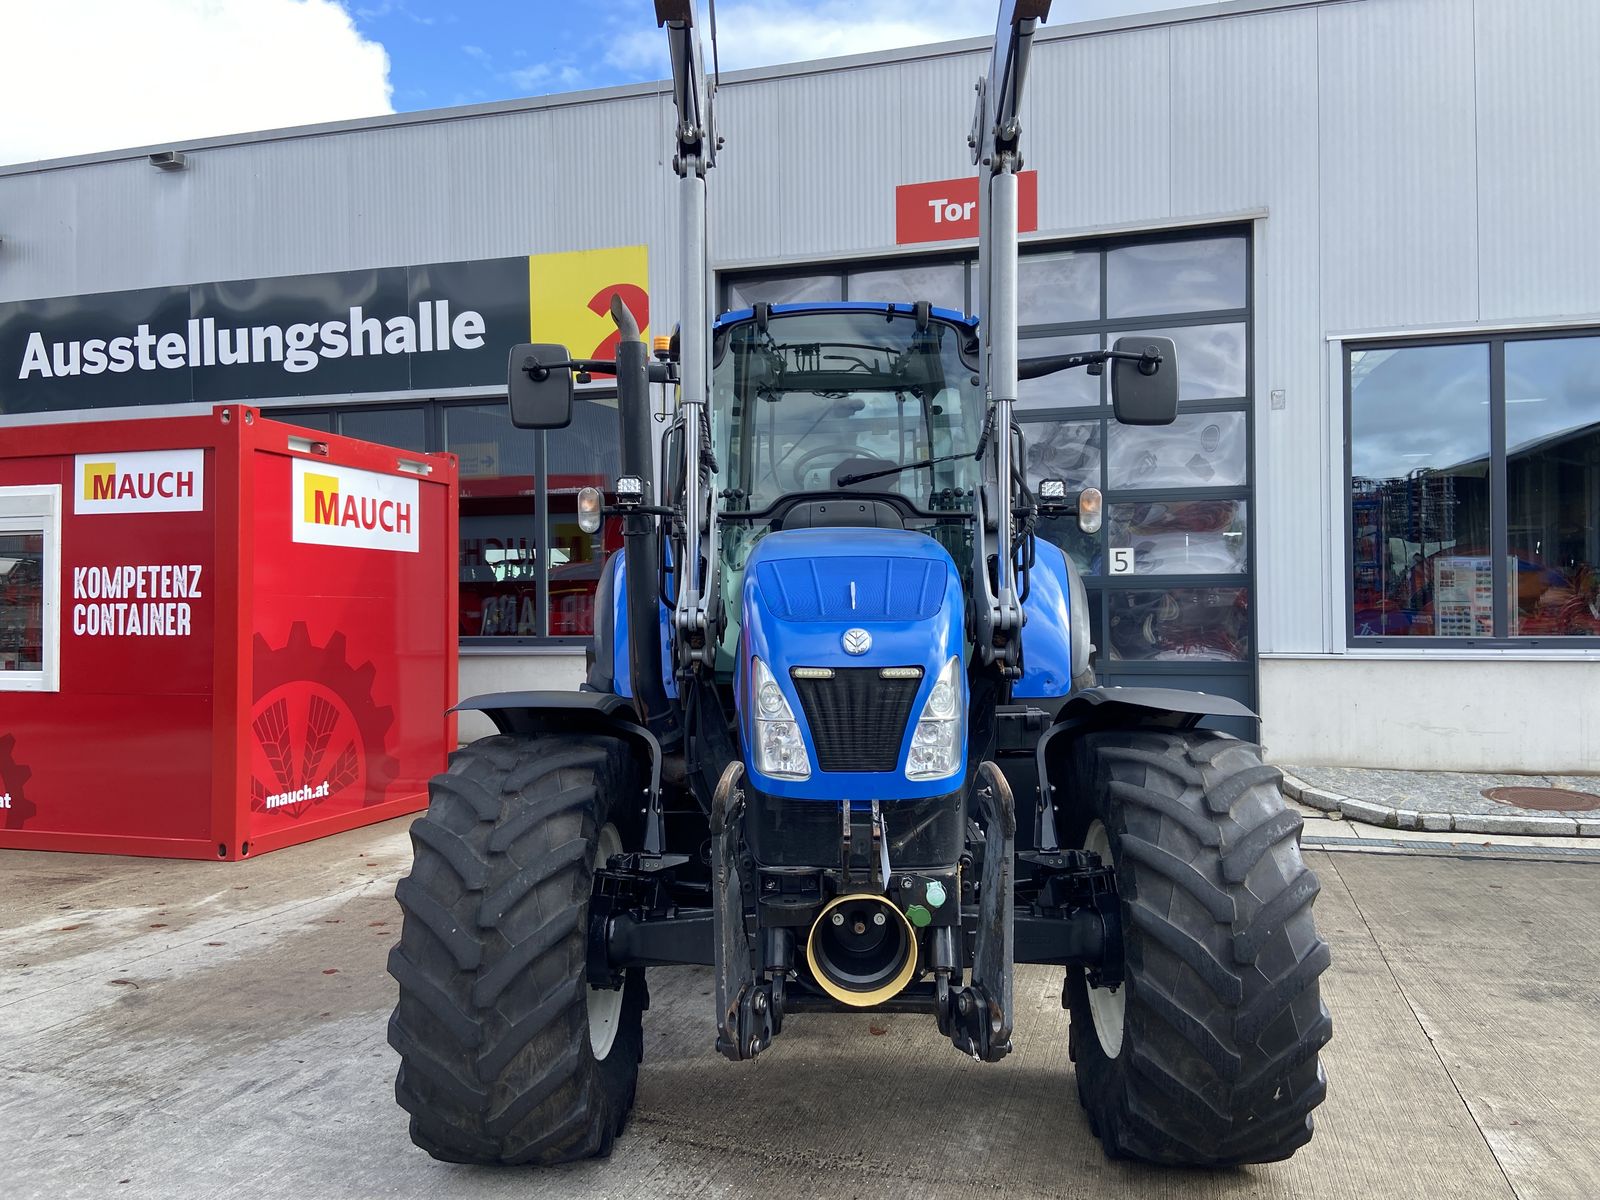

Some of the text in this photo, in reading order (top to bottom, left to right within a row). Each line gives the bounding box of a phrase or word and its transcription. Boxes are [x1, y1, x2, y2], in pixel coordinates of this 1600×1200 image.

[928, 198, 975, 224] Tor
[19, 284, 649, 380] Ausstellungshalle 2
[93, 471, 193, 500] MAUCH
[314, 490, 411, 534] MAUCH
[1114, 551, 1128, 572] 5
[73, 564, 202, 599] KOMPETENZ
[73, 602, 191, 636] CONTAINER
[266, 780, 330, 809] mauch.at
